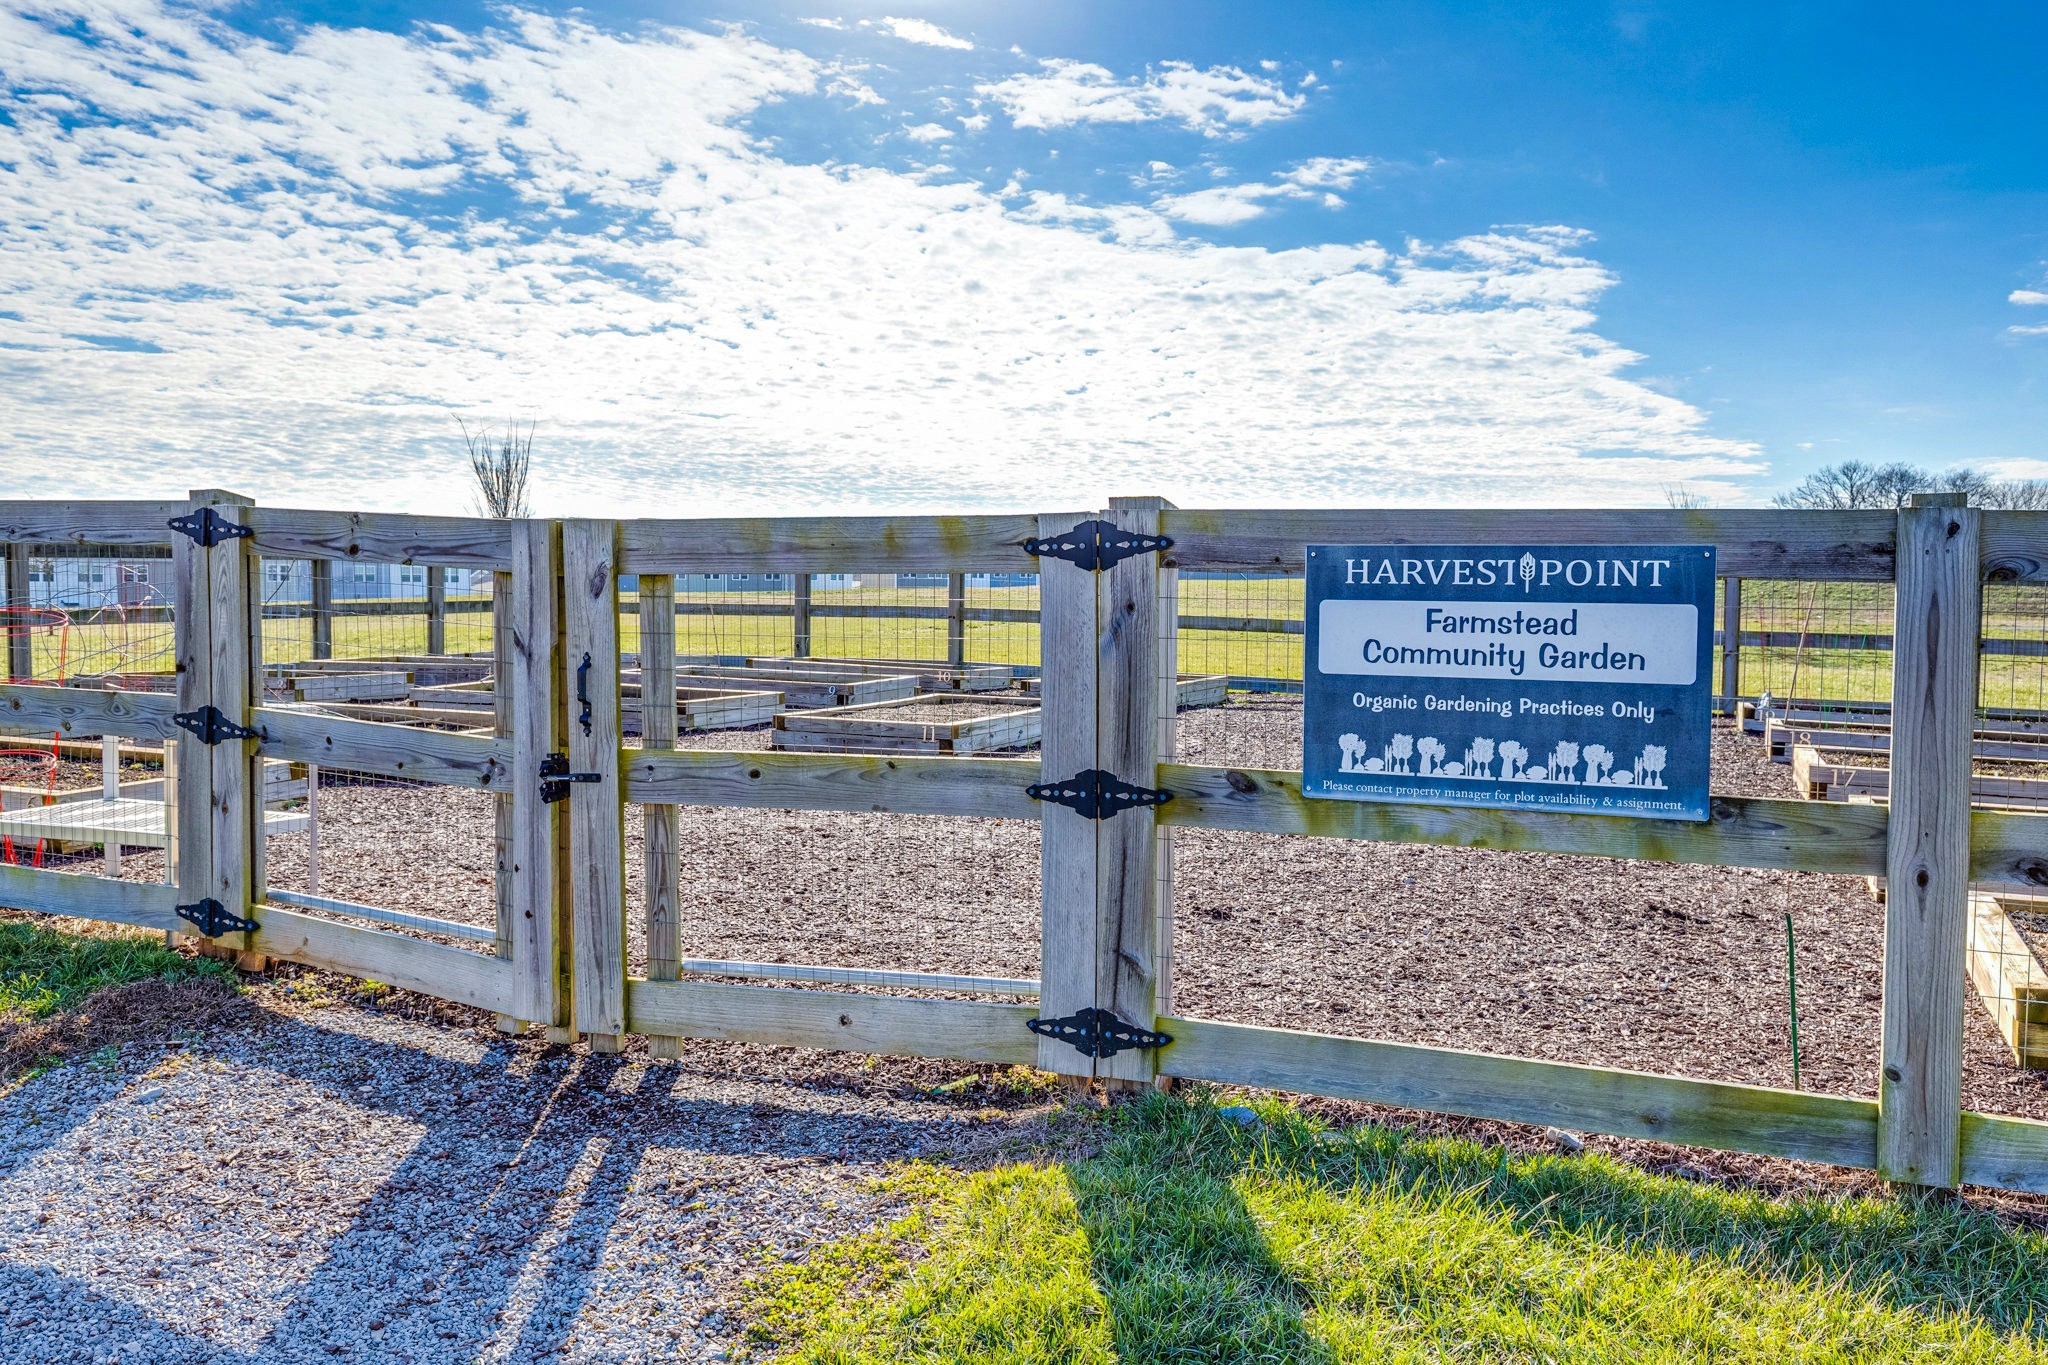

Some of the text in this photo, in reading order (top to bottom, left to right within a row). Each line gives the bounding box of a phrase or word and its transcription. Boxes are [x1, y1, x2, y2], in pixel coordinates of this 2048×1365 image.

[1345, 558, 1670, 587] HARVEST POINT
[1425, 608, 1578, 636] Farmstead
[1362, 638, 1645, 676] Community Garden
[938, 671, 951, 683] 10
[828, 685, 836, 698] 9
[1352, 692, 1655, 724] Organic Gardening Practices Only
[921, 725, 936, 743] 11
[1789, 731, 1812, 746] 18
[1831, 768, 1857, 788] 17
[1322, 779, 1686, 811] Please contact property manager for plot availability & assignment.
